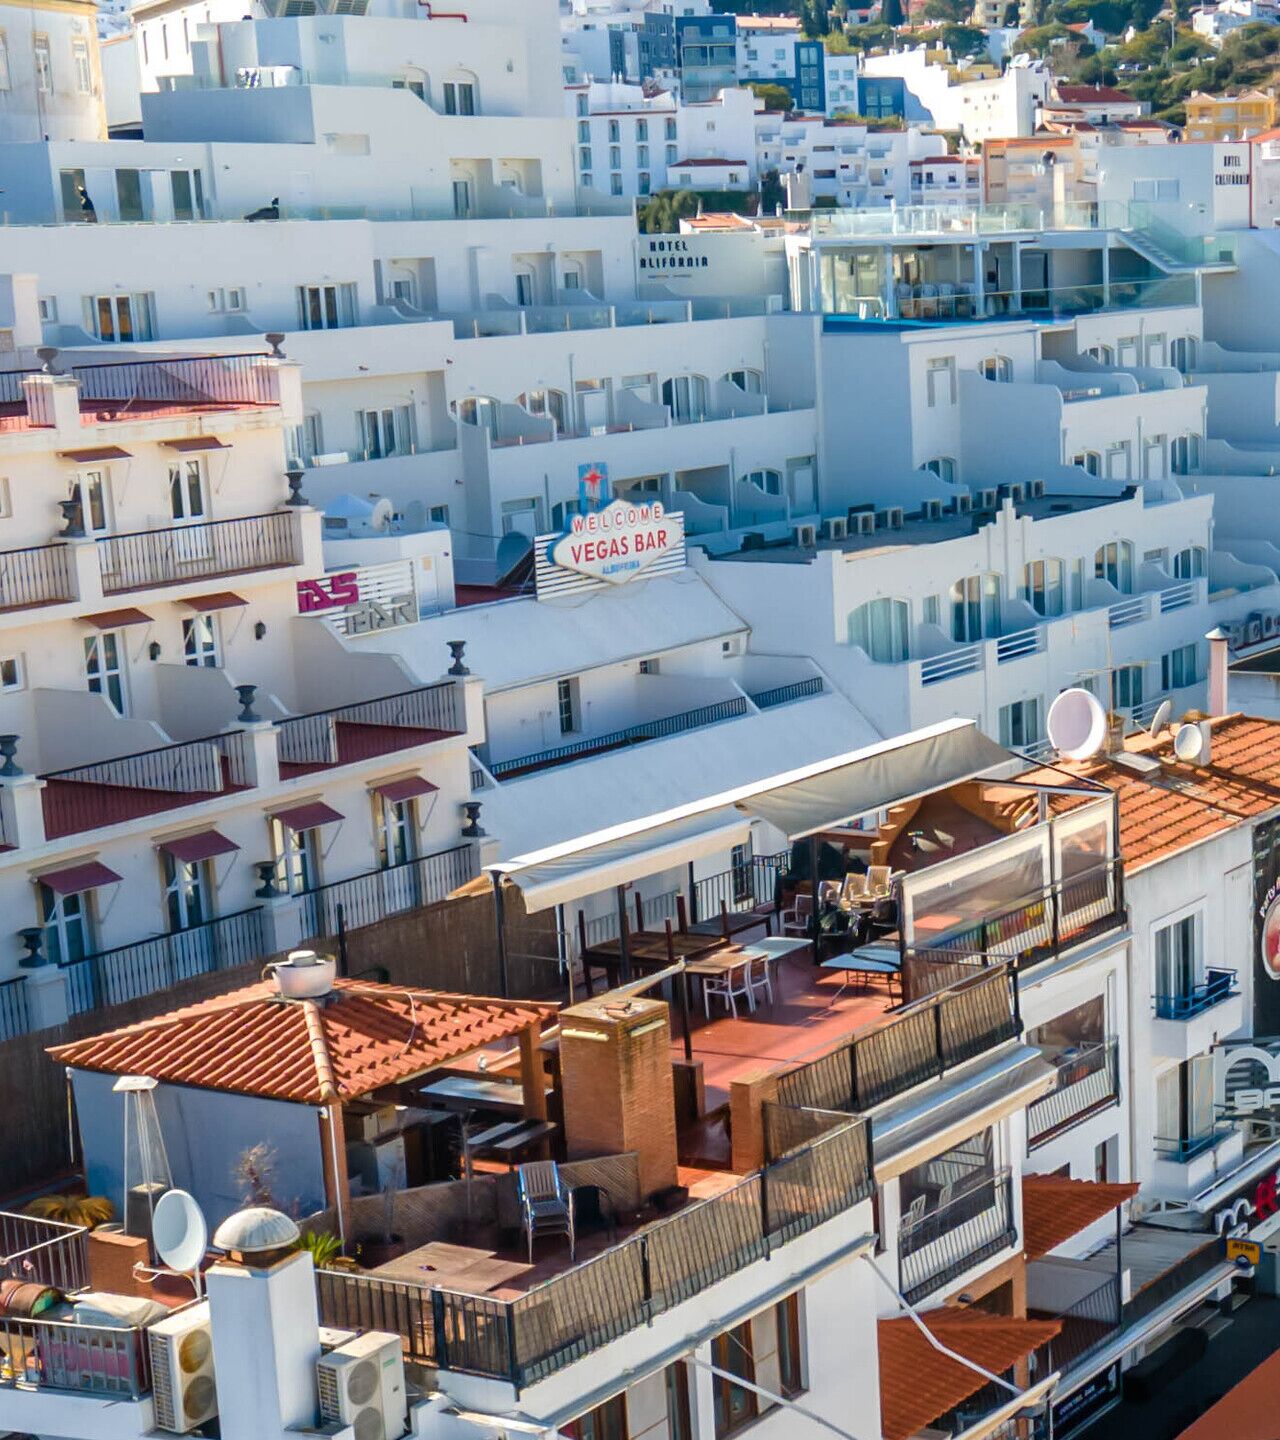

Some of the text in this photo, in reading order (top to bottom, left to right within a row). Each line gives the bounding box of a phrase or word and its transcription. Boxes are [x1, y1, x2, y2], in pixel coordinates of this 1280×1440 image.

[650, 241, 687, 251] HOTEL
[573, 505, 661, 533] WELCOME
[571, 529, 667, 564] VEGAS BAR
